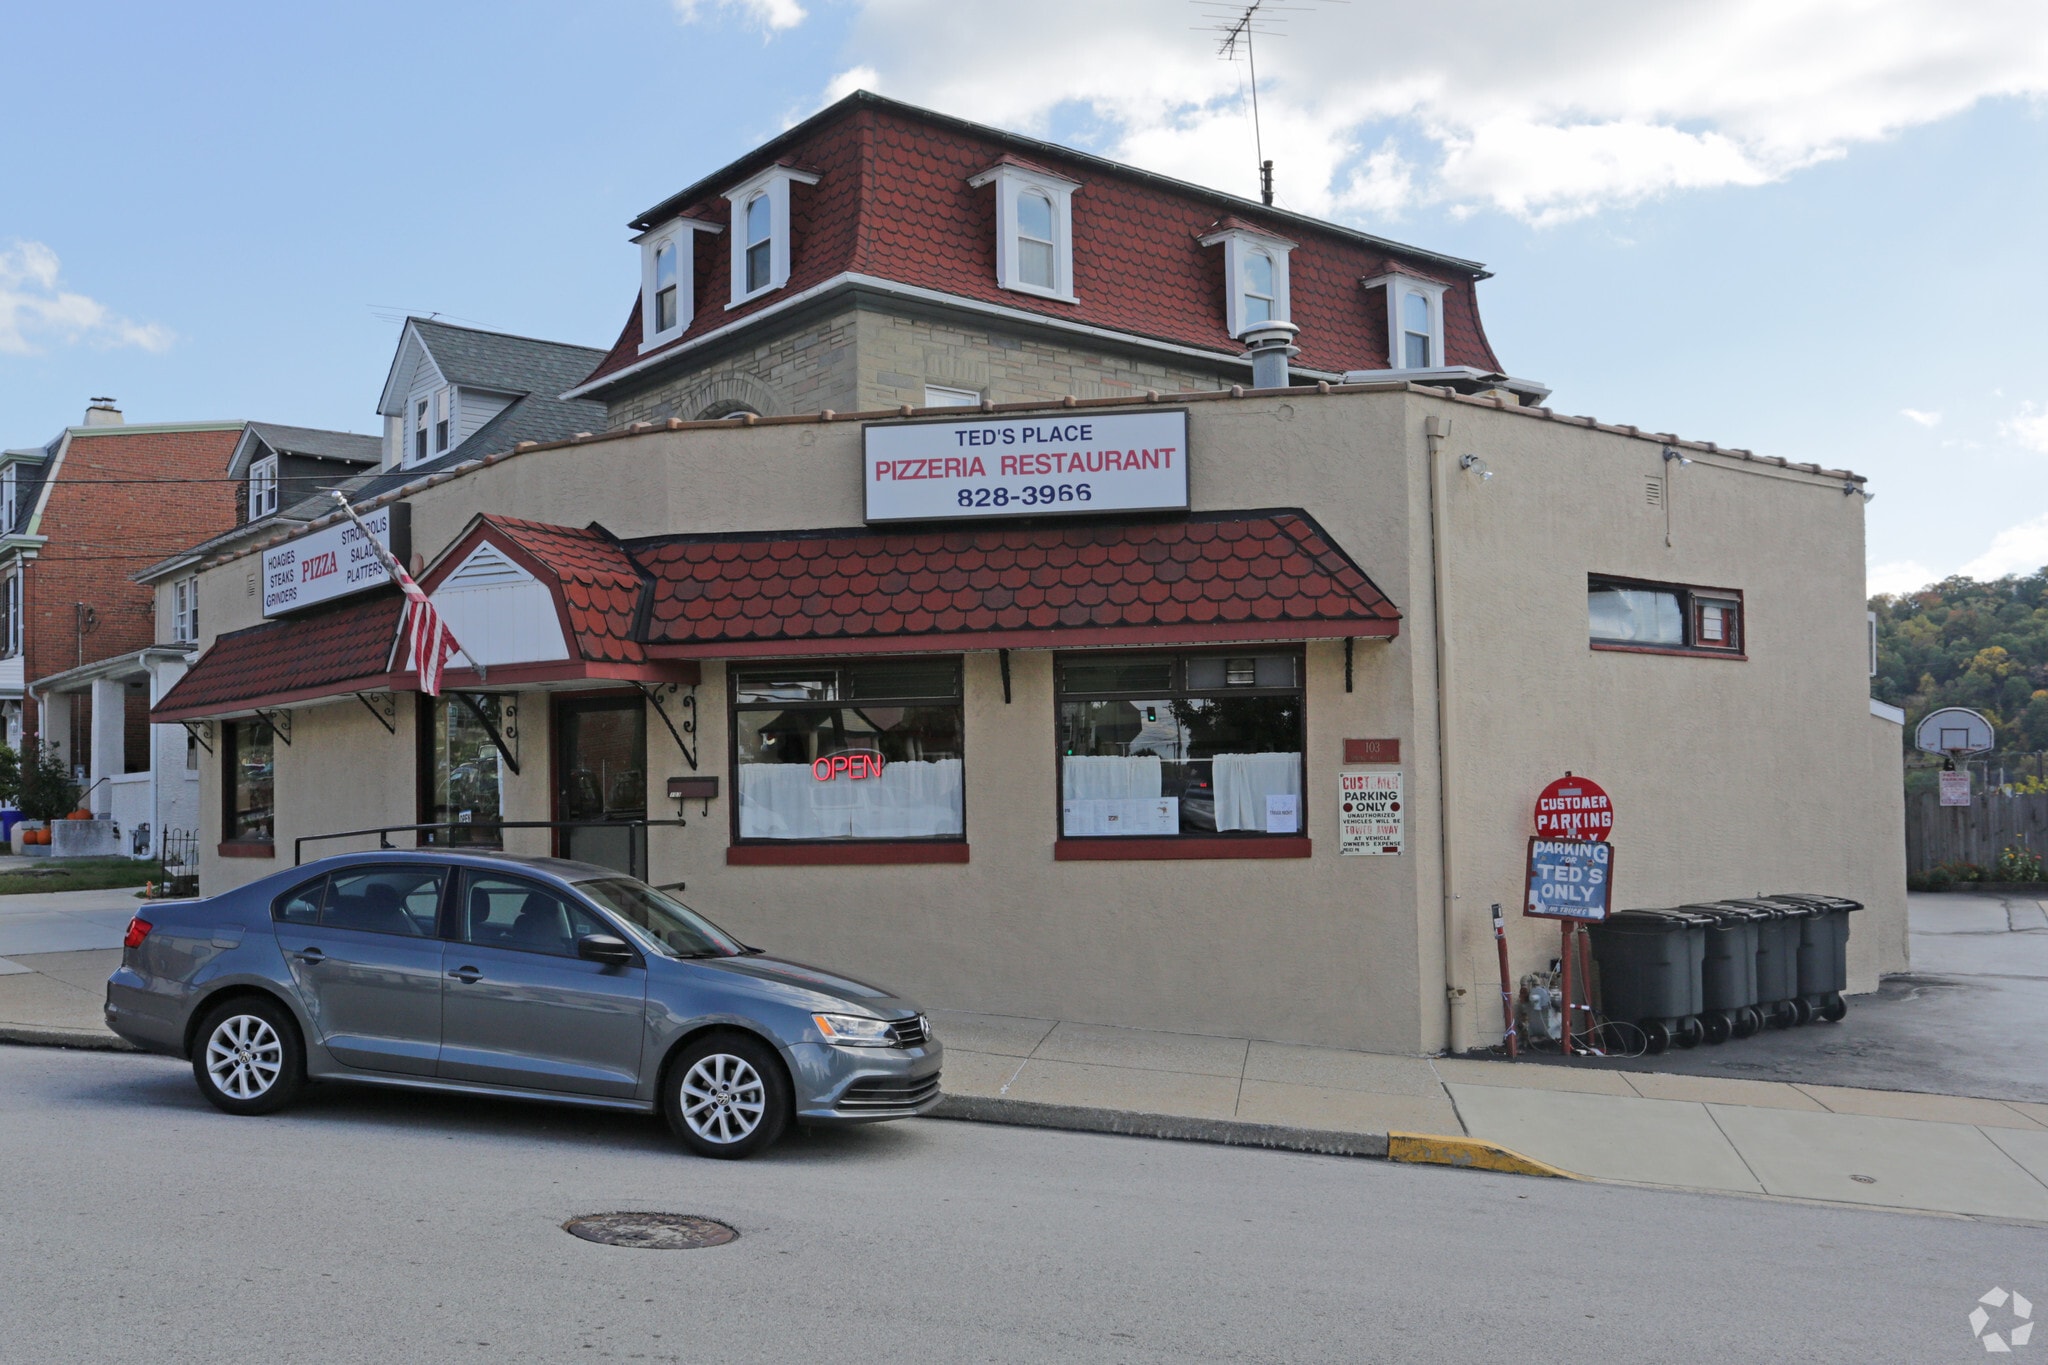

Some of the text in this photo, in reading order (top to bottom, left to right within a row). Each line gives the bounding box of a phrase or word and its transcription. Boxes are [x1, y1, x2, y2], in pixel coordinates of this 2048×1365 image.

[955, 424, 1093, 446] TED'S PLACE
[875, 448, 1176, 481] PIZZERIA RESTAURANT
[958, 483, 1092, 507] 828-3966
[268, 550, 295, 571] HOAGIES
[301, 551, 338, 583] PIZZA
[270, 569, 294, 588] STEAKS
[347, 562, 383, 584] PLATTERS
[266, 587, 297, 607] GRINDERS
[1365, 741, 1381, 753] 103
[813, 754, 881, 781] OPEN
[1343, 776, 1399, 790] CUSTMER
[1344, 791, 1398, 801] PARKING
[1540, 795, 1607, 811] CUSTOMER
[1356, 802, 1386, 812] ONLY
[1537, 811, 1611, 830] PARKING
[1532, 841, 1609, 864] PARKING
[1537, 864, 1603, 884] TED'S
[1541, 883, 1595, 902] ONLY
